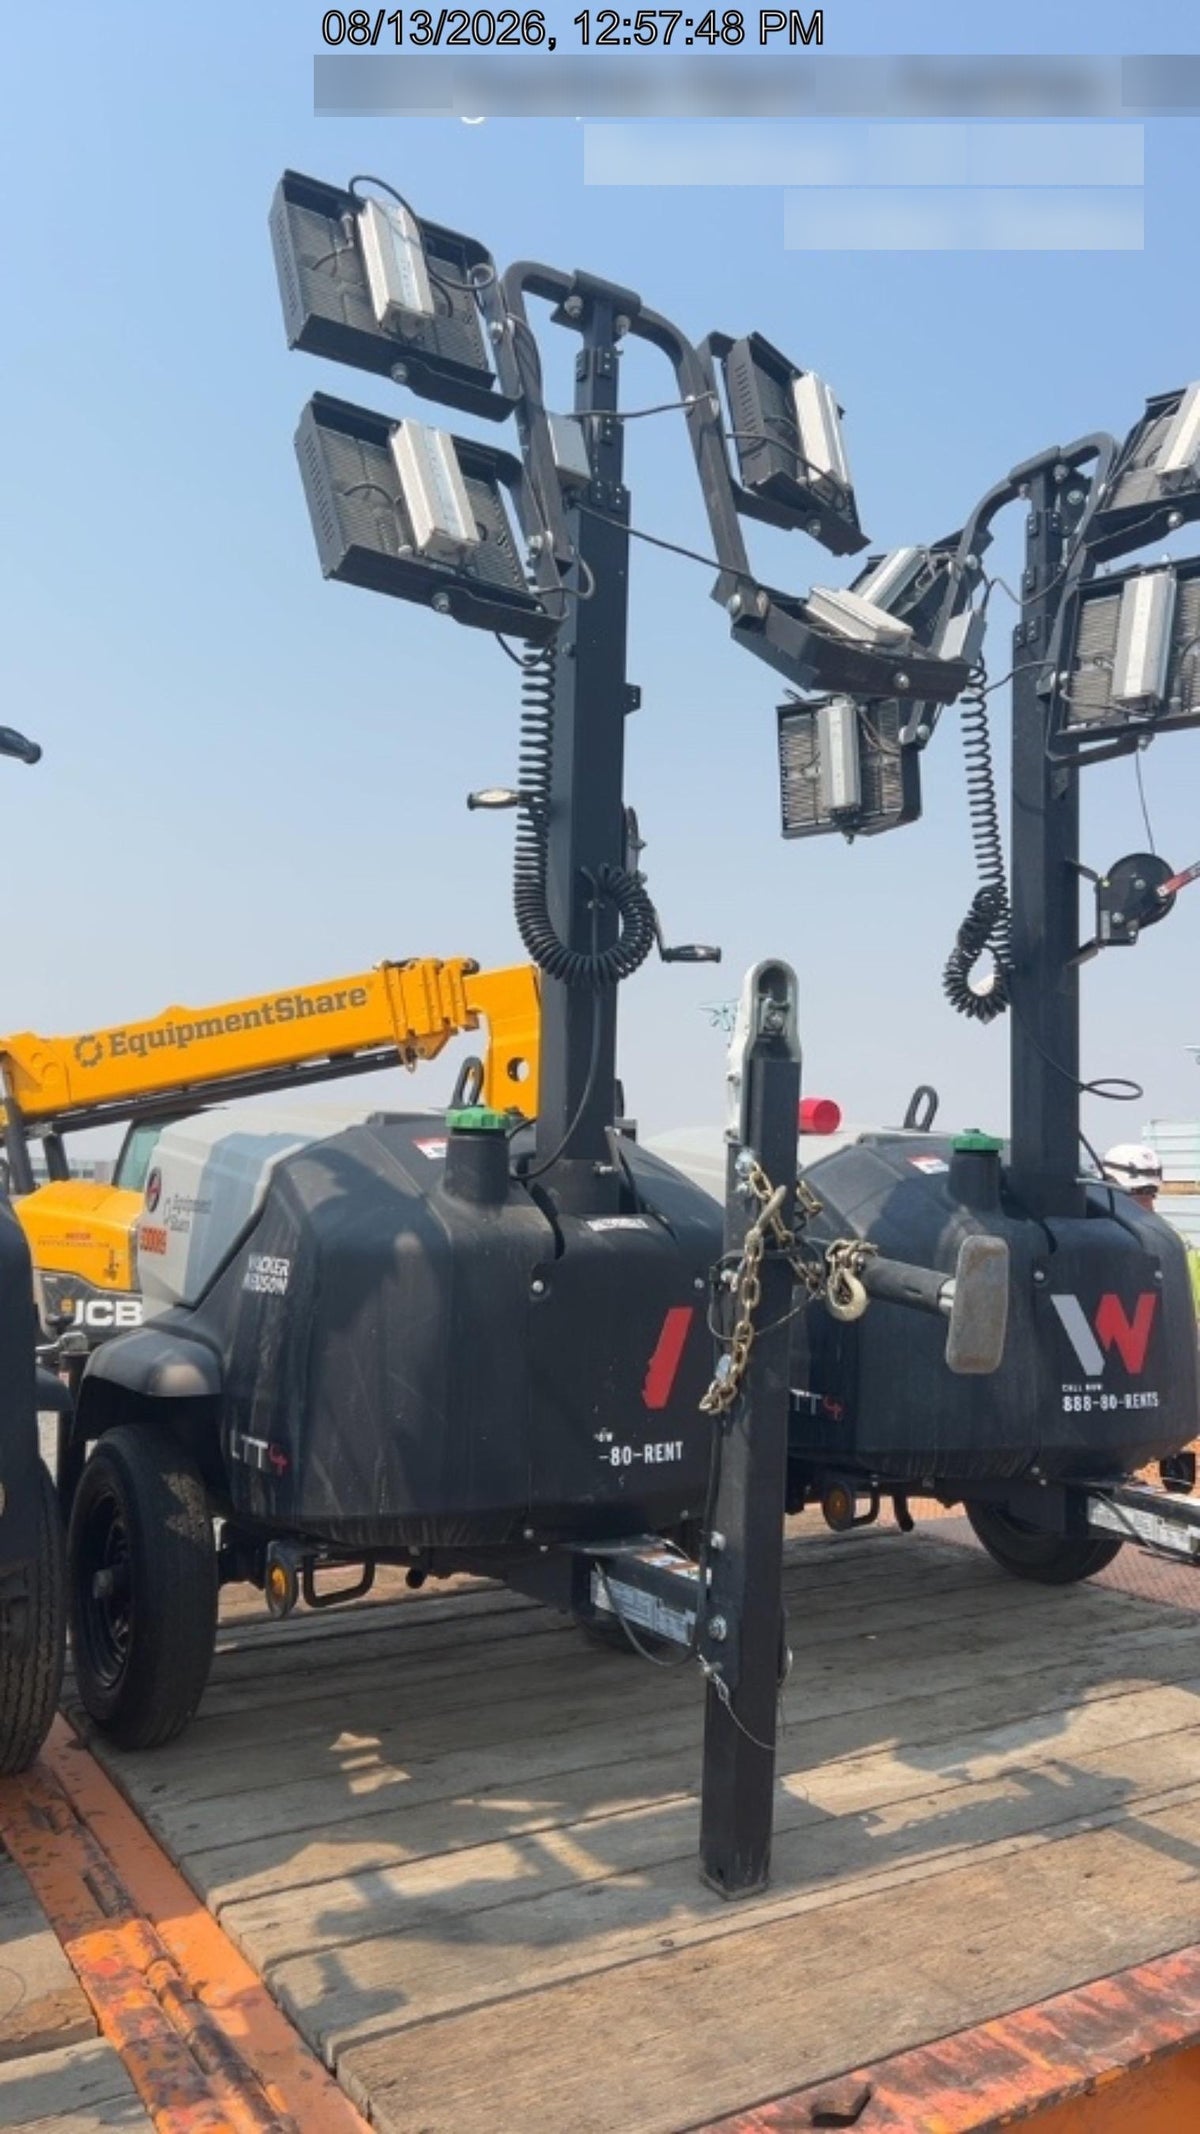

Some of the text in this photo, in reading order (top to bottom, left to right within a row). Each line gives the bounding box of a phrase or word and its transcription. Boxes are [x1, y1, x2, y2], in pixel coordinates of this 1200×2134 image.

[109, 987, 367, 1057] EquipmentShare
[74, 1300, 143, 1326] JCB
[790, 1388, 843, 1420] TT4
